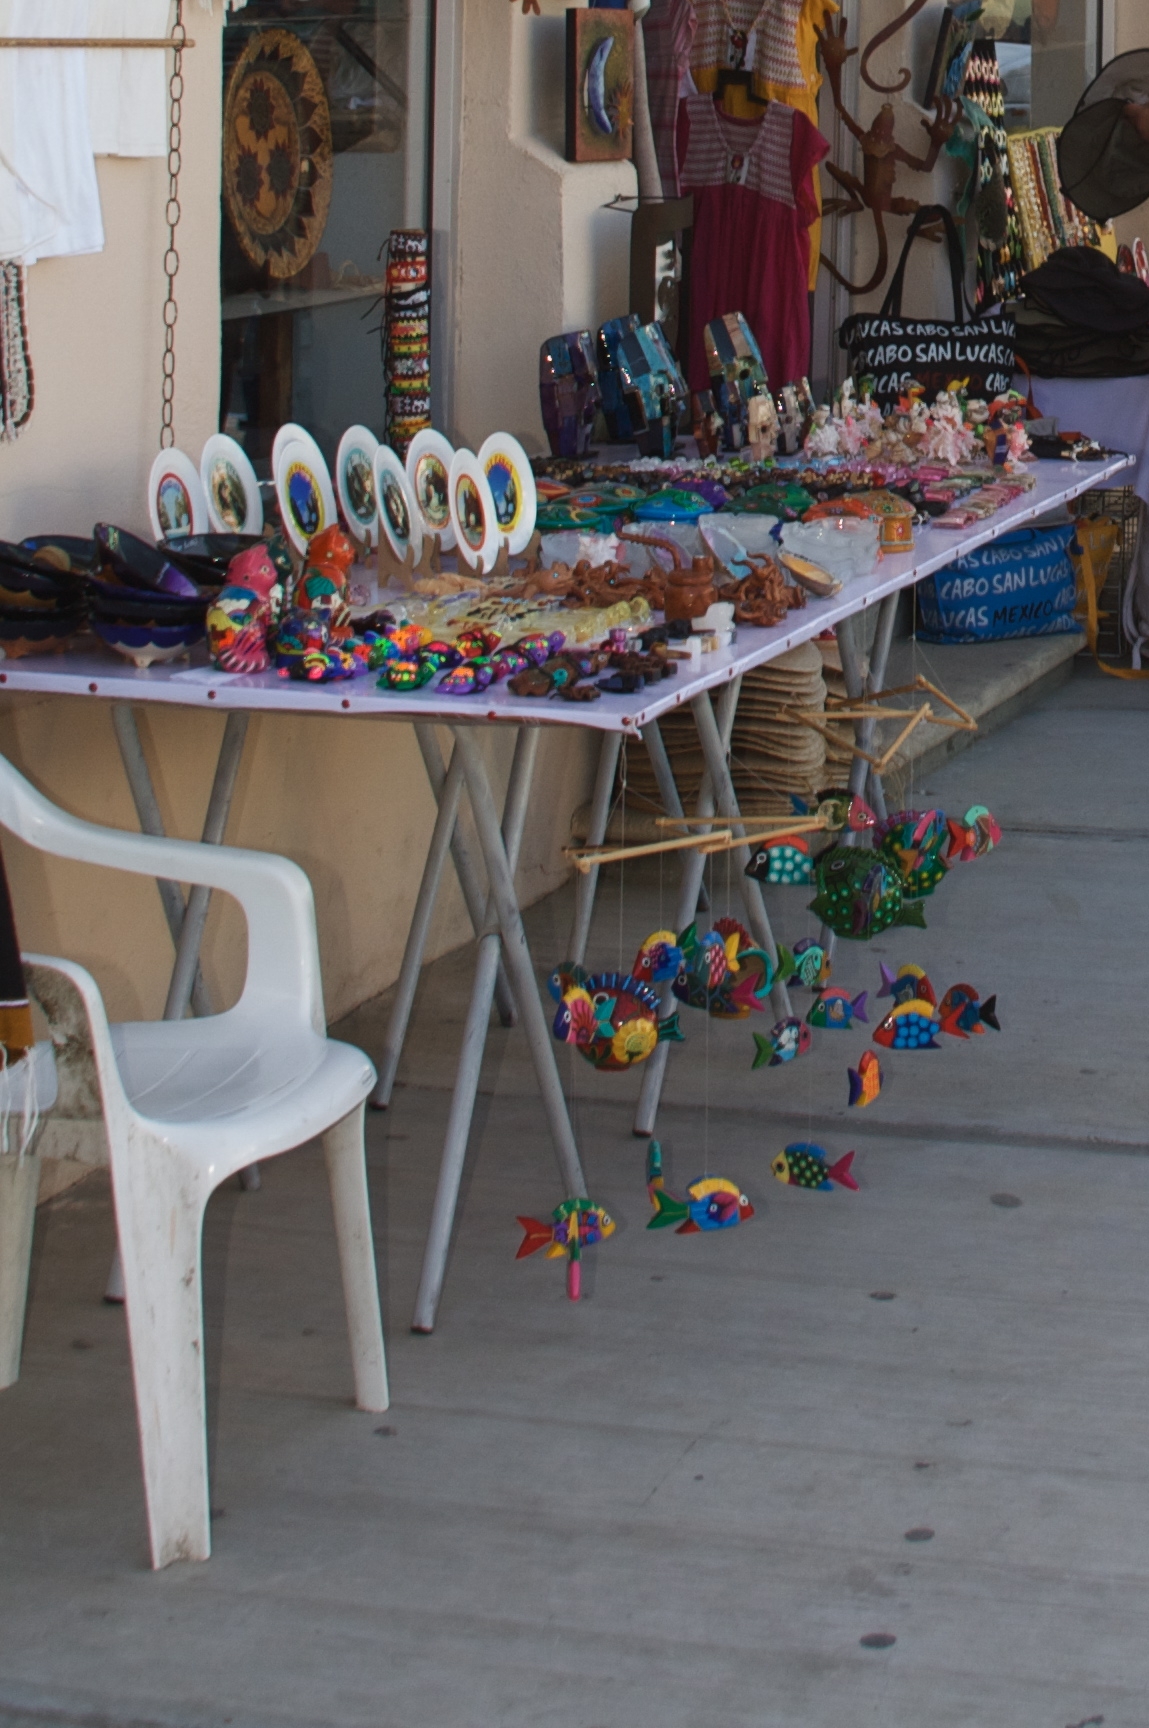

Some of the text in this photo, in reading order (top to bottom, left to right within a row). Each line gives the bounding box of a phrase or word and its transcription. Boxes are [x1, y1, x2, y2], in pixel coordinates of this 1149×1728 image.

[906, 322, 949, 337] CABO
[951, 319, 988, 337] SAN
[867, 343, 912, 367] CABO
[916, 341, 951, 363] SAN
[955, 341, 1004, 364] LUCAS
[982, 549, 1023, 566] CABO
[1023, 538, 1059, 559] SAN
[940, 576, 989, 601] CABO
[992, 566, 1027, 595] SAN
[993, 599, 1053, 627] MEXICO
